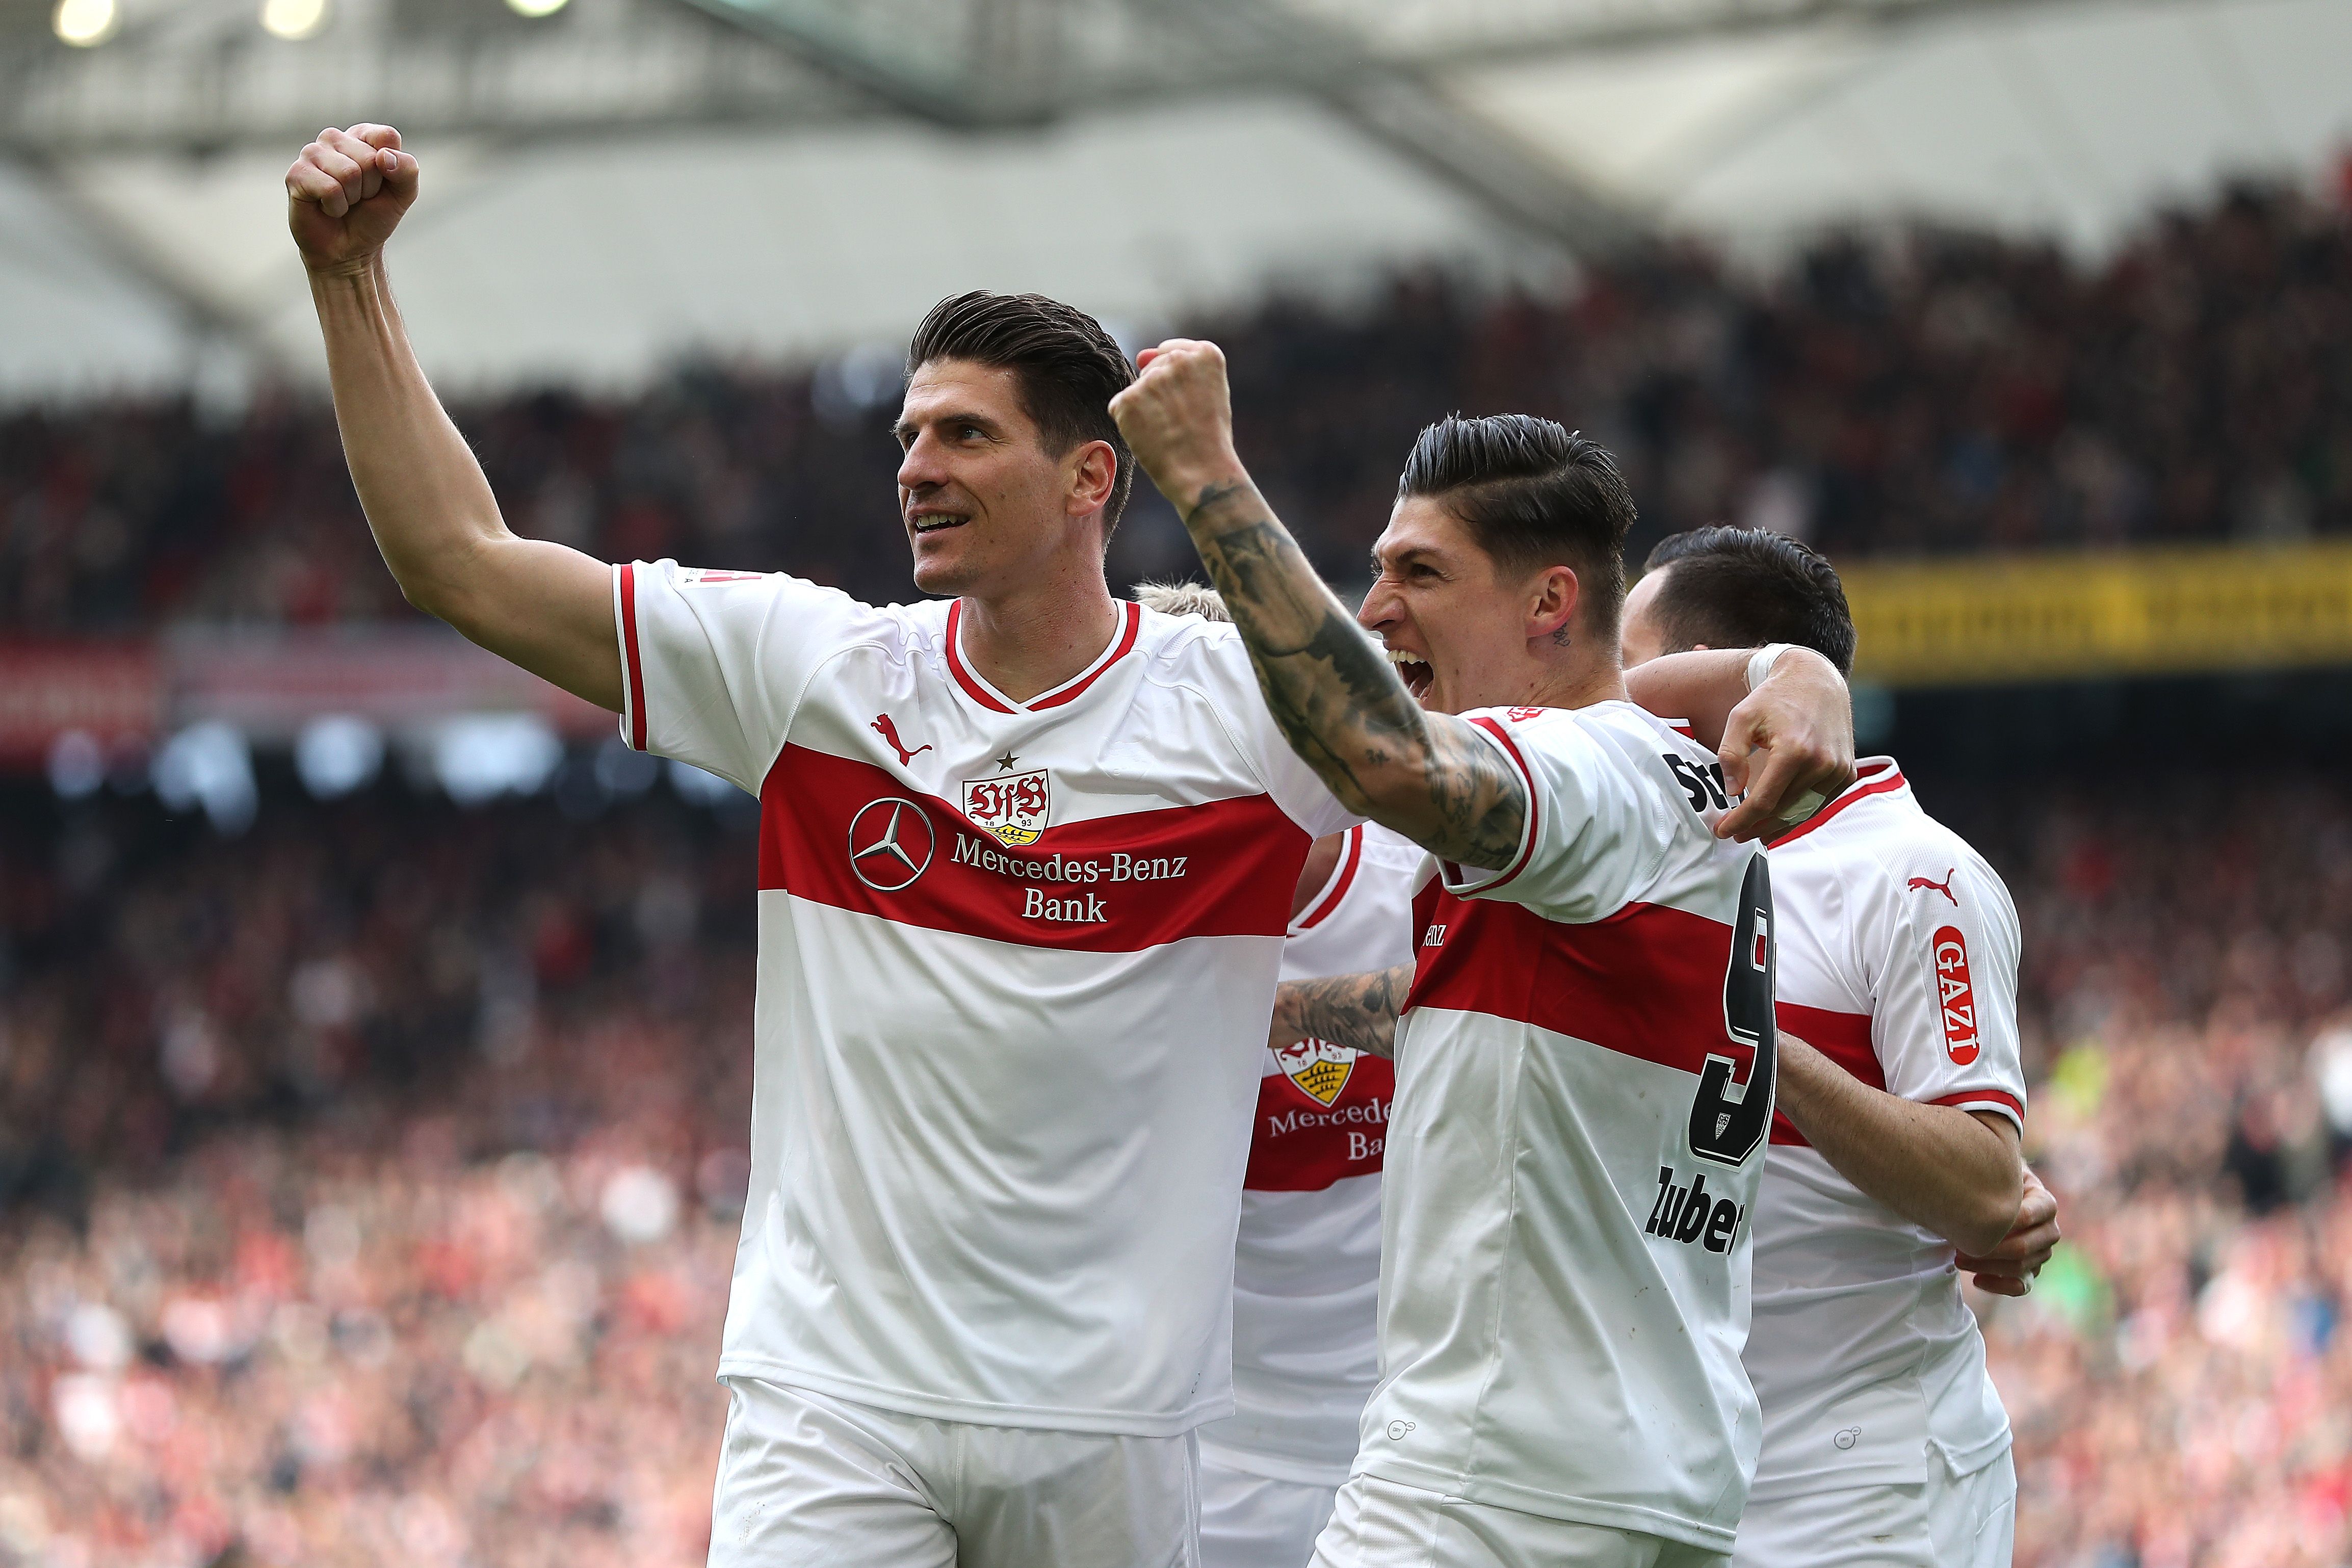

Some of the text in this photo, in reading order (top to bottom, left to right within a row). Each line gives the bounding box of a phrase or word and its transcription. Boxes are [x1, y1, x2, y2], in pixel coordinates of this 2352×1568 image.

[950, 833, 1188, 883] Mercedes-Benz
[1022, 887, 1107, 922] Bank
[1423, 924, 1447, 947] enz
[1689, 851, 1776, 1169] 9
[1937, 942, 1976, 1053] GAZI
